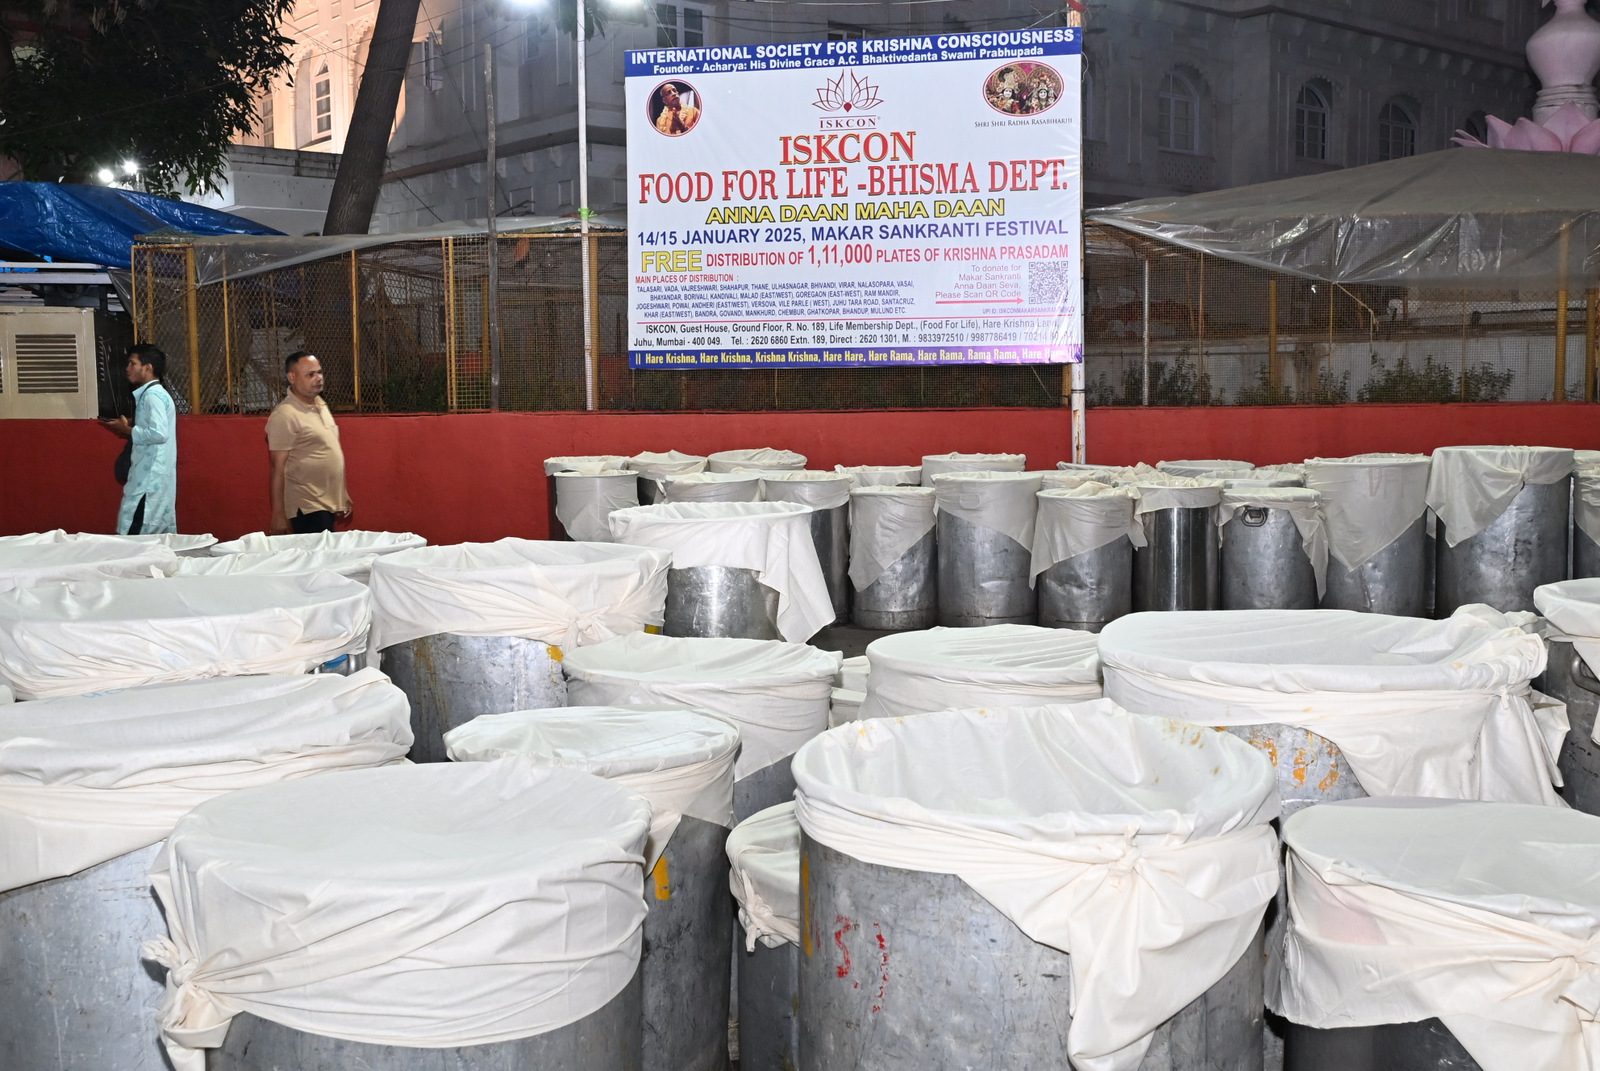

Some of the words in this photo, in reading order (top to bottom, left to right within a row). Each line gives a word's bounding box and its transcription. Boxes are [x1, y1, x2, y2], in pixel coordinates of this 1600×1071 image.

[632, 46, 751, 64] INTERNATIONAL
[756, 43, 822, 58] SOCIETY
[827, 41, 857, 54] FOR
[863, 37, 933, 53] KRISHNA
[938, 29, 1074, 49] CONSCIOUSNESS
[654, 63, 694, 74] Founder
[703, 61, 747, 73] Acharya:
[750, 60, 766, 69] His
[770, 58, 801, 68] Divine
[804, 56, 835, 67] Grace
[838, 55, 859, 65] A.C.
[863, 51, 937, 64] Bhaktivedanta
[941, 49, 976, 60] Swami
[980, 46, 1043, 59] Prabhupada
[779, 131, 916, 166] ISKCON
[639, 171, 713, 204] FOOD
[722, 169, 778, 202] FOR
[786, 167, 848, 200] LIFE
[989, 159, 1067, 192] DEPT.
[705, 205, 776, 225] ANNA
[780, 203, 849, 223] DAAN
[855, 200, 929, 221] MAHA
[934, 198, 1004, 218] DAAN
[638, 231, 677, 246] 14/15
[682, 229, 760, 245] JANUARY
[765, 227, 805, 245] 2025,
[812, 225, 873, 241] MAKAR
[879, 222, 979, 239] SANKRANTI
[986, 220, 1068, 236] FESTIVAL
[641, 250, 703, 273] FREE
[707, 252, 785, 267] DISTRIBUTION
[789, 251, 804, 265] OF
[808, 243, 873, 268] 1,11,000
[876, 248, 920, 263] PLATES
[924, 248, 940, 262] OF
[944, 247, 996, 261] KRISHNA
[1001, 245, 1068, 259] PRASADAM
[982, 264, 1008, 272] donate
[653, 275, 677, 283] PLACES
[679, 275, 687, 283] OF
[689, 274, 733, 283] DISTRIBUTION
[959, 273, 982, 281] Makar
[985, 272, 1021, 280] Sankranti
[954, 282, 974, 290] Anna
[935, 291, 961, 299] Please
[964, 290, 983, 298] Scan
[985, 290, 999, 298] QR
[1001, 290, 1021, 298] Code
[646, 324, 678, 334] ISKCON,
[680, 324, 702, 333] Guest
[704, 324, 730, 333] House,
[732, 323, 760, 332] Ground
[763, 322, 784, 332] Floor,
[787, 322, 794, 331] R.
[797, 322, 809, 331] No.
[812, 322, 827, 332] 189,
[829, 322, 843, 330] Life
[846, 321, 893, 332] Membership
[896, 320, 917, 332] Dept.,
[920, 320, 942, 331] (Food
[946, 320, 958, 329] For
[961, 320, 980, 330] Life),
[983, 319, 1001, 328] Hare
[1004, 319, 1034, 327] Krishna
[634, 338, 654, 347] Juhu,
[656, 337, 685, 346] Mumbai
[692, 337, 705, 345] 400
[707, 337, 722, 345] 049.
[731, 336, 744, 345] Tel.
[751, 336, 768, 345] 2620
[770, 336, 788, 344] 6860
[790, 335, 809, 344] Extn.
[812, 335, 827, 345] 189,
[830, 334, 852, 344] Direct
[860, 334, 877, 343] 2620
[880, 334, 899, 344] 1301,
[902, 334, 911, 342] M.
[918, 333, 964, 342] 9833972510
[971, 332, 1017, 342] 9987786419
[646, 353, 663, 364] Hare
[666, 353, 697, 364] Krishna,
[700, 352, 718, 363] Hare
[721, 352, 753, 364] Krishna,
[756, 351, 786, 363] Krishna
[788, 351, 820, 363] Krishna,
[823, 351, 842, 362] Hare
[845, 350, 866, 363] Hare,
[869, 350, 887, 361] Hare
[890, 350, 915, 362] Rama,
[918, 350, 937, 360] Hare
[940, 349, 965, 361] Rama,
[968, 349, 991, 360] Rama
[994, 349, 1019, 360] Rama,
